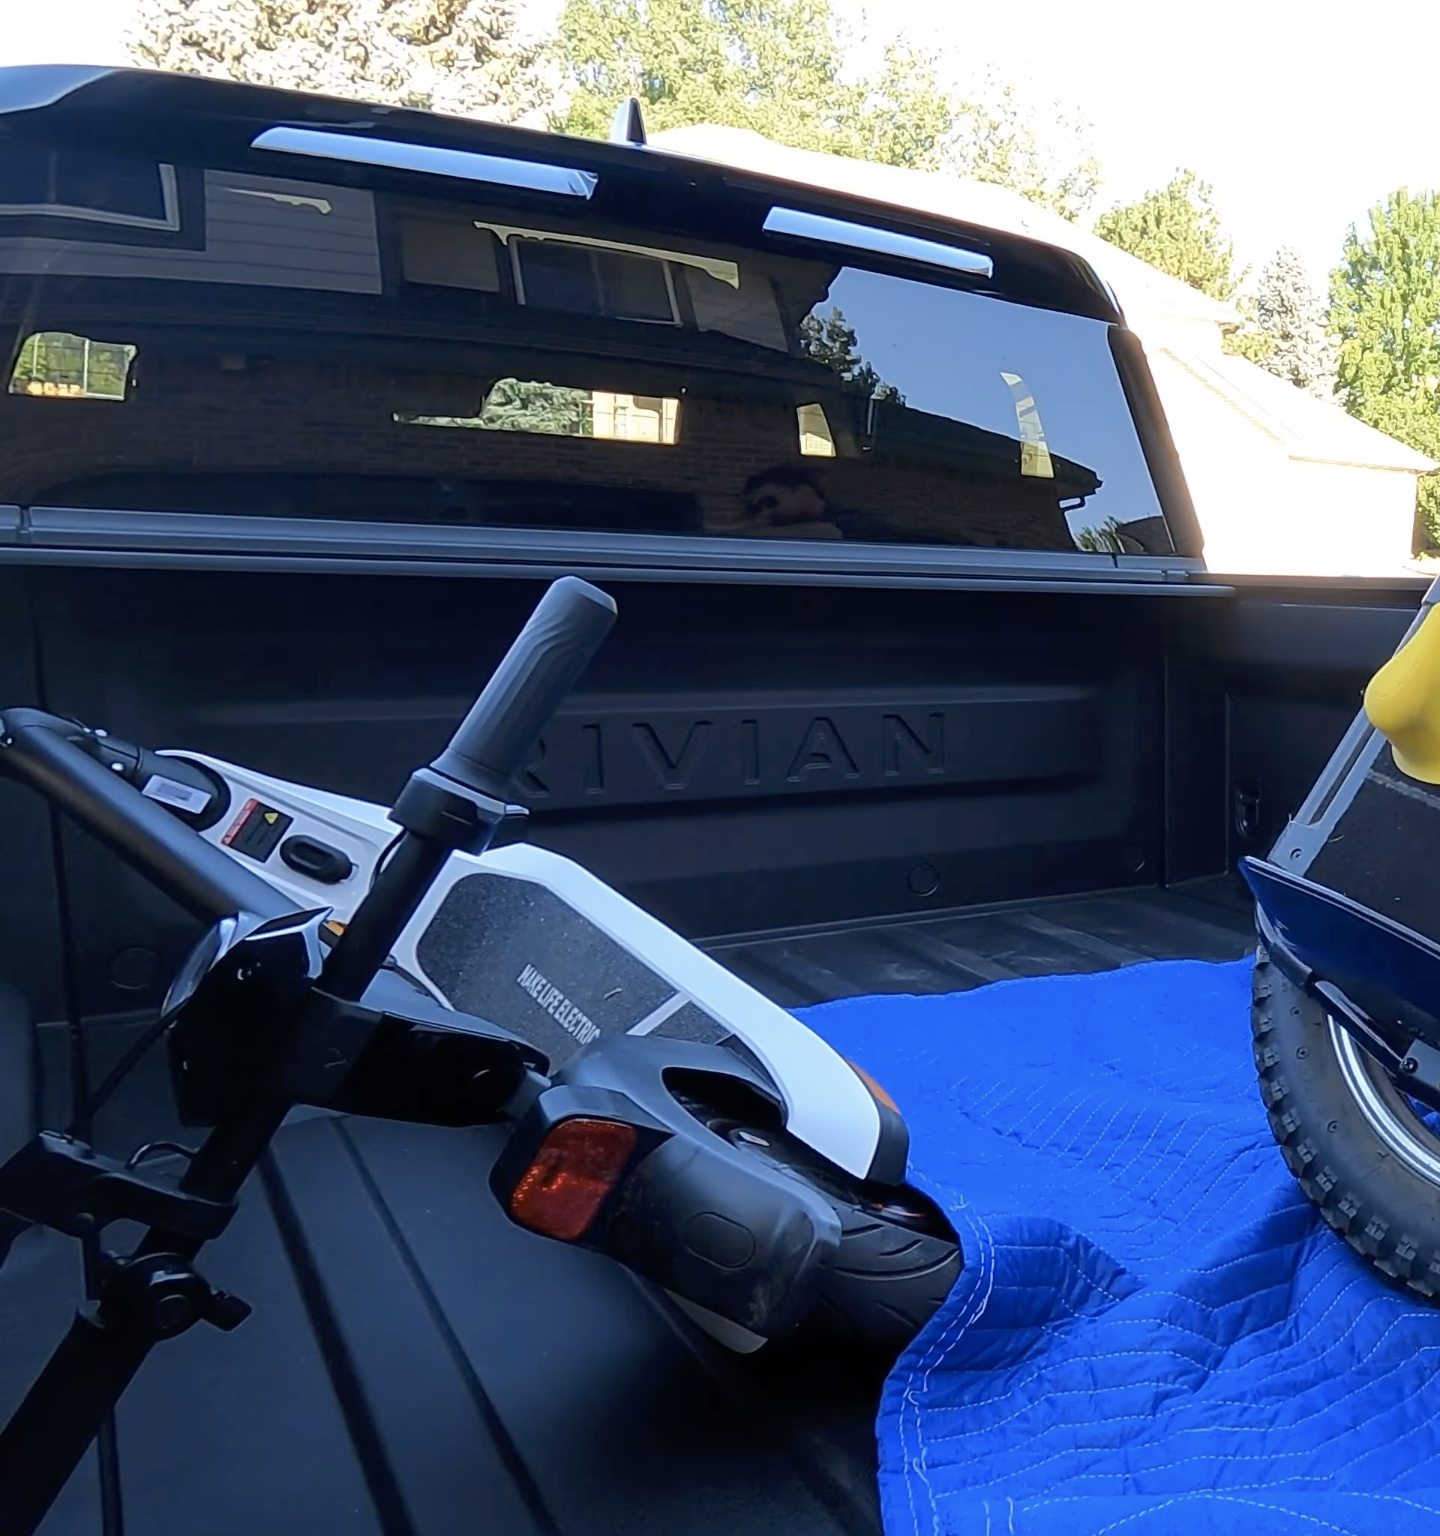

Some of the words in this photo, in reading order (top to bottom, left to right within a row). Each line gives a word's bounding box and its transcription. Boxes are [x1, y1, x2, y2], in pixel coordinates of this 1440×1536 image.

[516, 963, 547, 998] MAKE
[537, 982, 565, 1014] LIFE
[553, 998, 601, 1045] ELECTRIC
